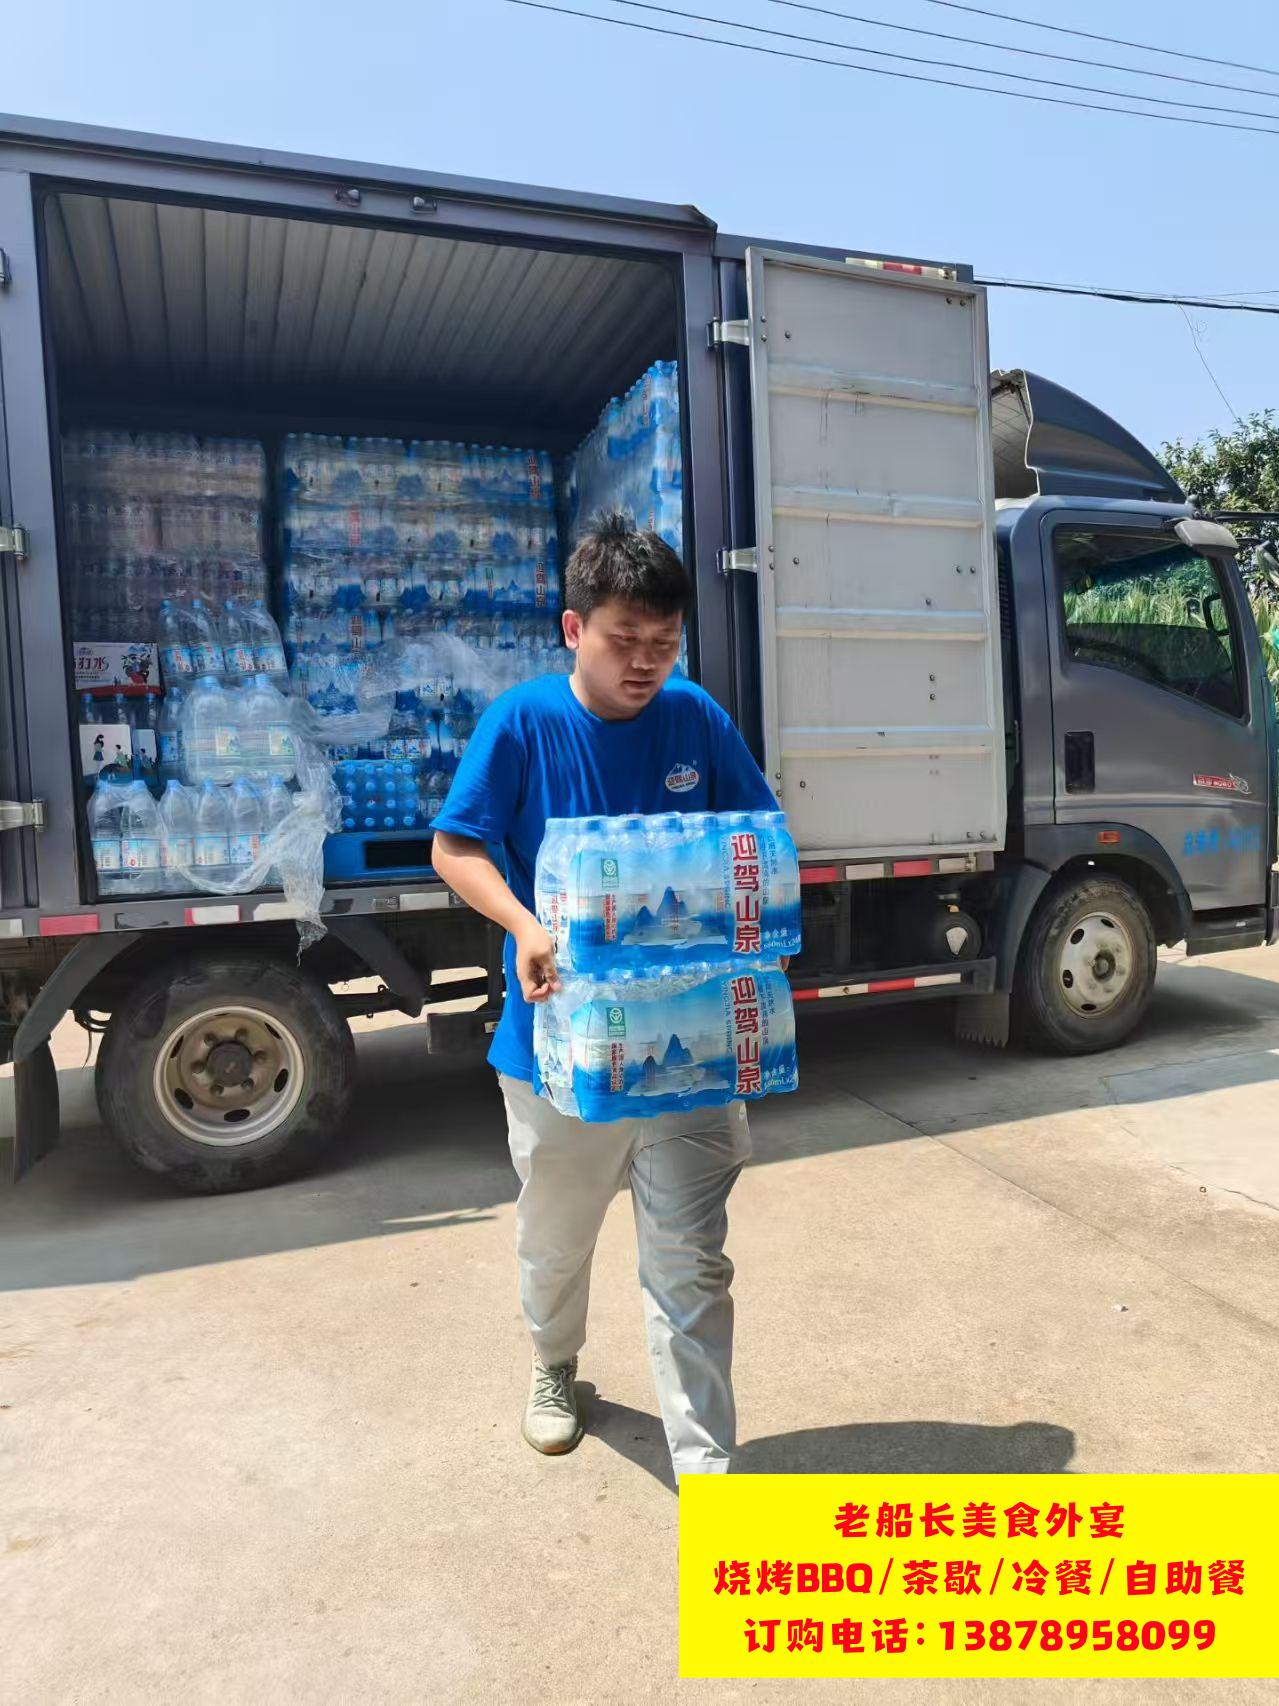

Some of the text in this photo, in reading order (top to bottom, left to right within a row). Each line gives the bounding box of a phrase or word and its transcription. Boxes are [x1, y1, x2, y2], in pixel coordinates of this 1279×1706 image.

[731, 833, 760, 953] 迎驾山泉
[731, 976, 761, 1094] 迎驾山泉
